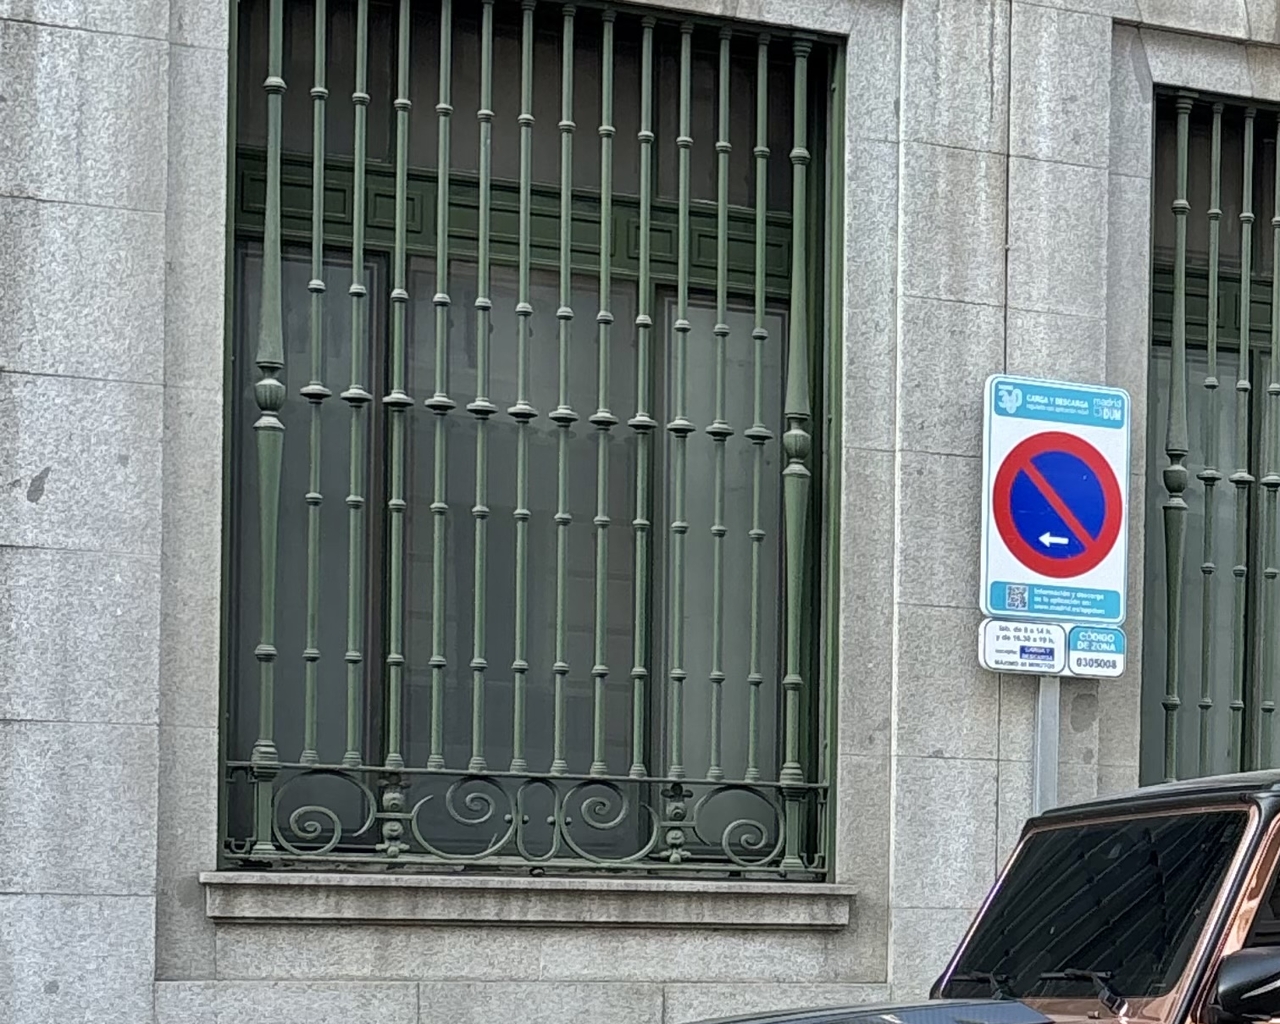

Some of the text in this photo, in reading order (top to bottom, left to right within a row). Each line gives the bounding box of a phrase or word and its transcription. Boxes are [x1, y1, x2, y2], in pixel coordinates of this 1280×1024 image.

[1049, 396, 1055, 405] Y
[1079, 629, 1115, 643] CÓDIGO
[1077, 640, 1116, 651] DE ZONA
